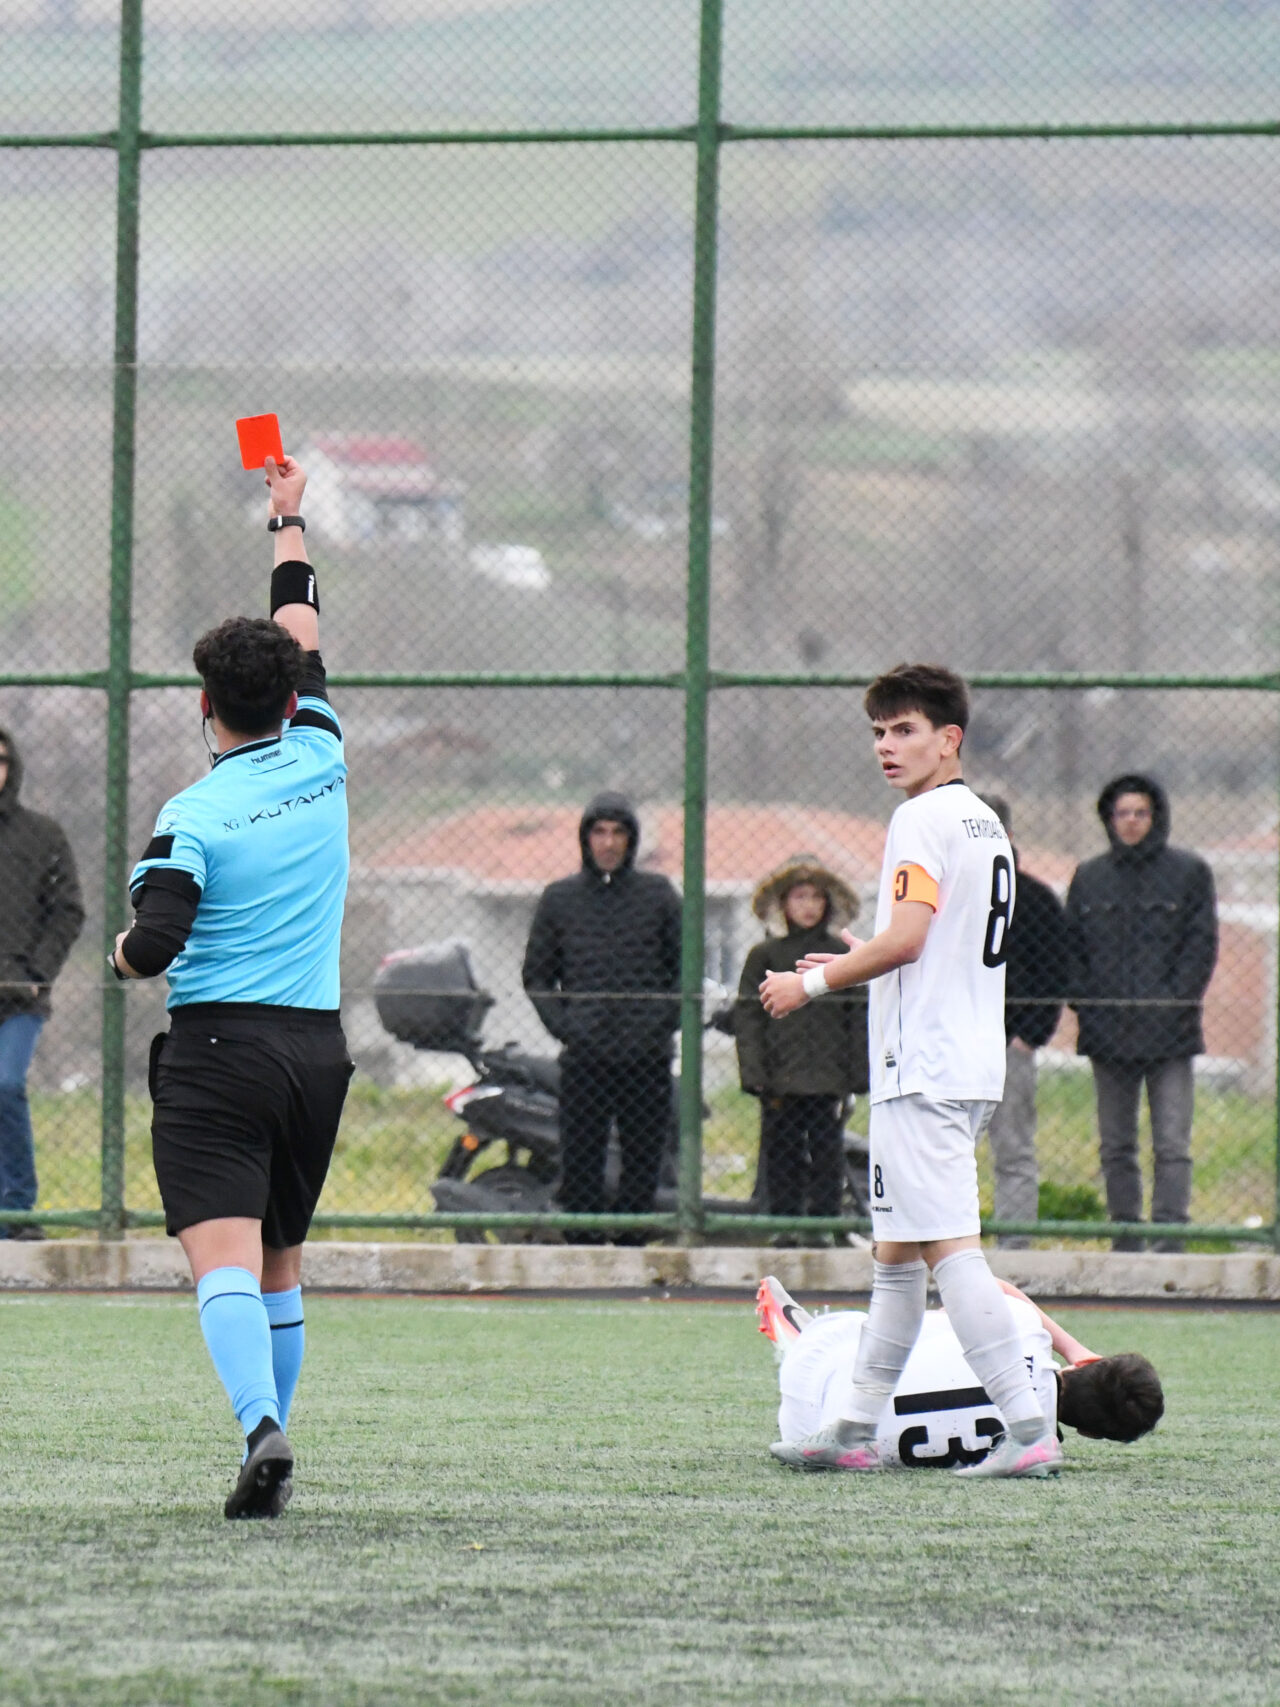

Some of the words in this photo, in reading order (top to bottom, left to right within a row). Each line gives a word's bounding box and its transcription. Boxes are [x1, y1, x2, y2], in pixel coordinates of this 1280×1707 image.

[250, 748, 282, 765] hummel
[222, 818, 240, 832] NG
[982, 855, 1011, 968] 8
[874, 1164, 885, 1199] 8
[894, 1386, 1006, 1469] 13
